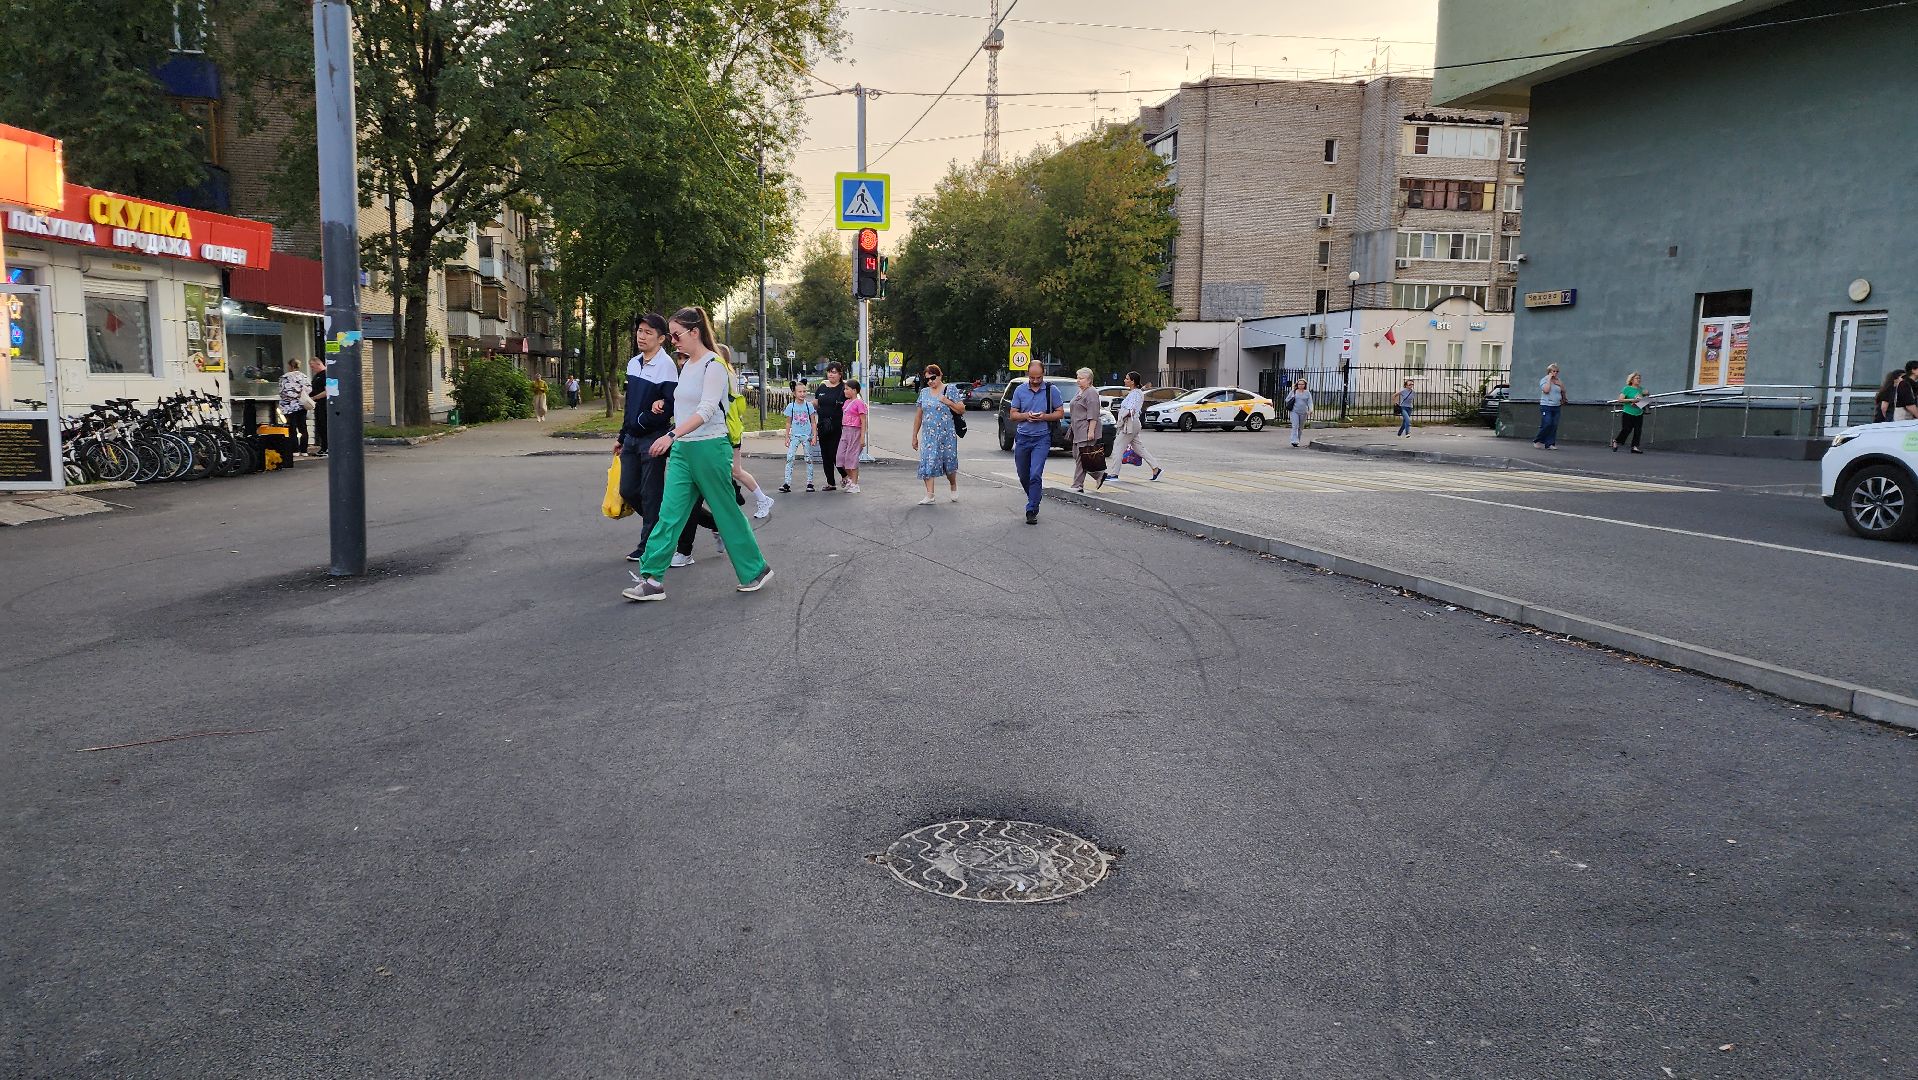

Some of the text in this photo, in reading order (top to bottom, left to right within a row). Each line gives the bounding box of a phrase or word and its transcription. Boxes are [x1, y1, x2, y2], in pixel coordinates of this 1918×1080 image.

[89, 193, 193, 240] СКУПКА
[8, 210, 248, 265] ПОКУПКА ПРОДАЖА ОБМЕН
[866, 257, 876, 270] 14
[1561, 292, 1570, 302] 12
